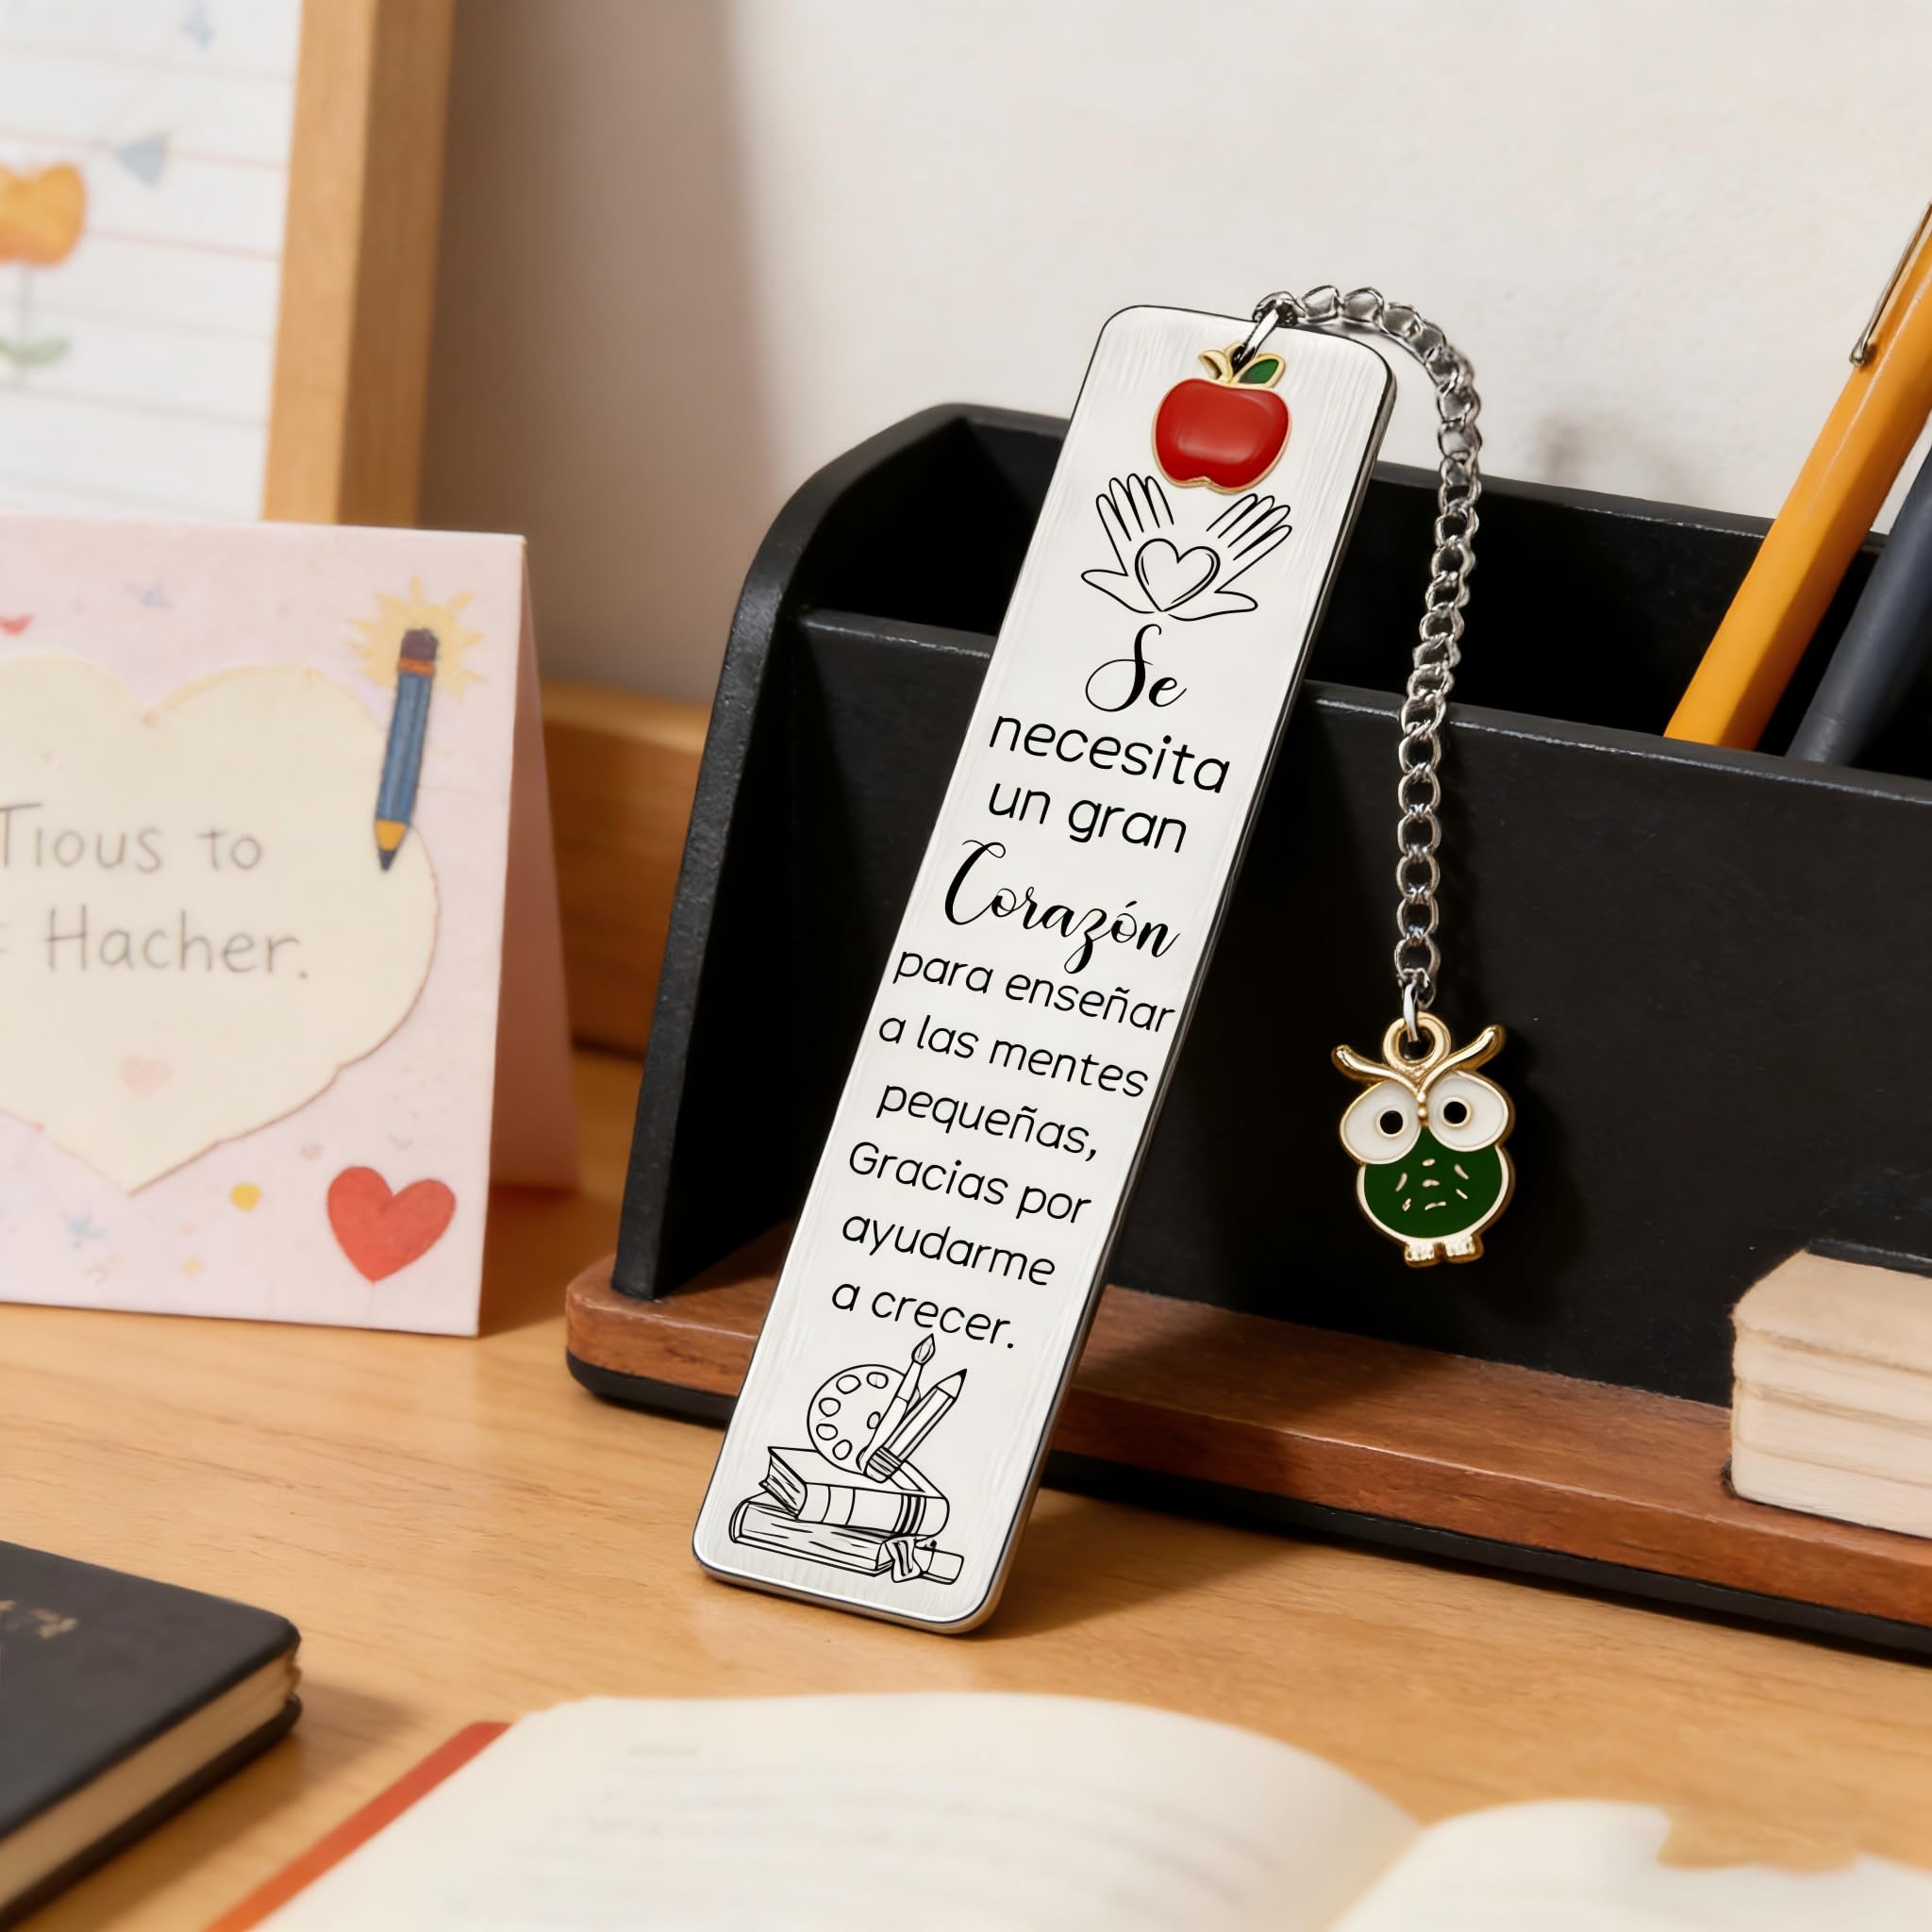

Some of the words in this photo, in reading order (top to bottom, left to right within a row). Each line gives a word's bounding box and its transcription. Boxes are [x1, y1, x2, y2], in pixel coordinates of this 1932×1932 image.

[1085, 624, 1188, 712] Se
[989, 715, 1231, 793] necesita
[197, 828, 264, 872] to
[988, 783, 1051, 824] un
[1068, 799, 1188, 853] gran
[43, 904, 309, 979] Hacher.
[943, 839, 1181, 974] Corazón
[892, 951, 994, 994] para
[1005, 973, 1175, 1033] enseñar
[878, 1017, 907, 1044] a
[917, 1014, 979, 1058] las
[989, 1037, 1149, 1098] mentes
[876, 1084, 1097, 1161] pequeñas,
[848, 1141, 1008, 1206] Gracias
[1015, 1185, 1092, 1224] por
[842, 1214, 1056, 1286] ayudarme
[832, 1282, 860, 1311] a
[871, 1291, 1014, 1349] crecer.
